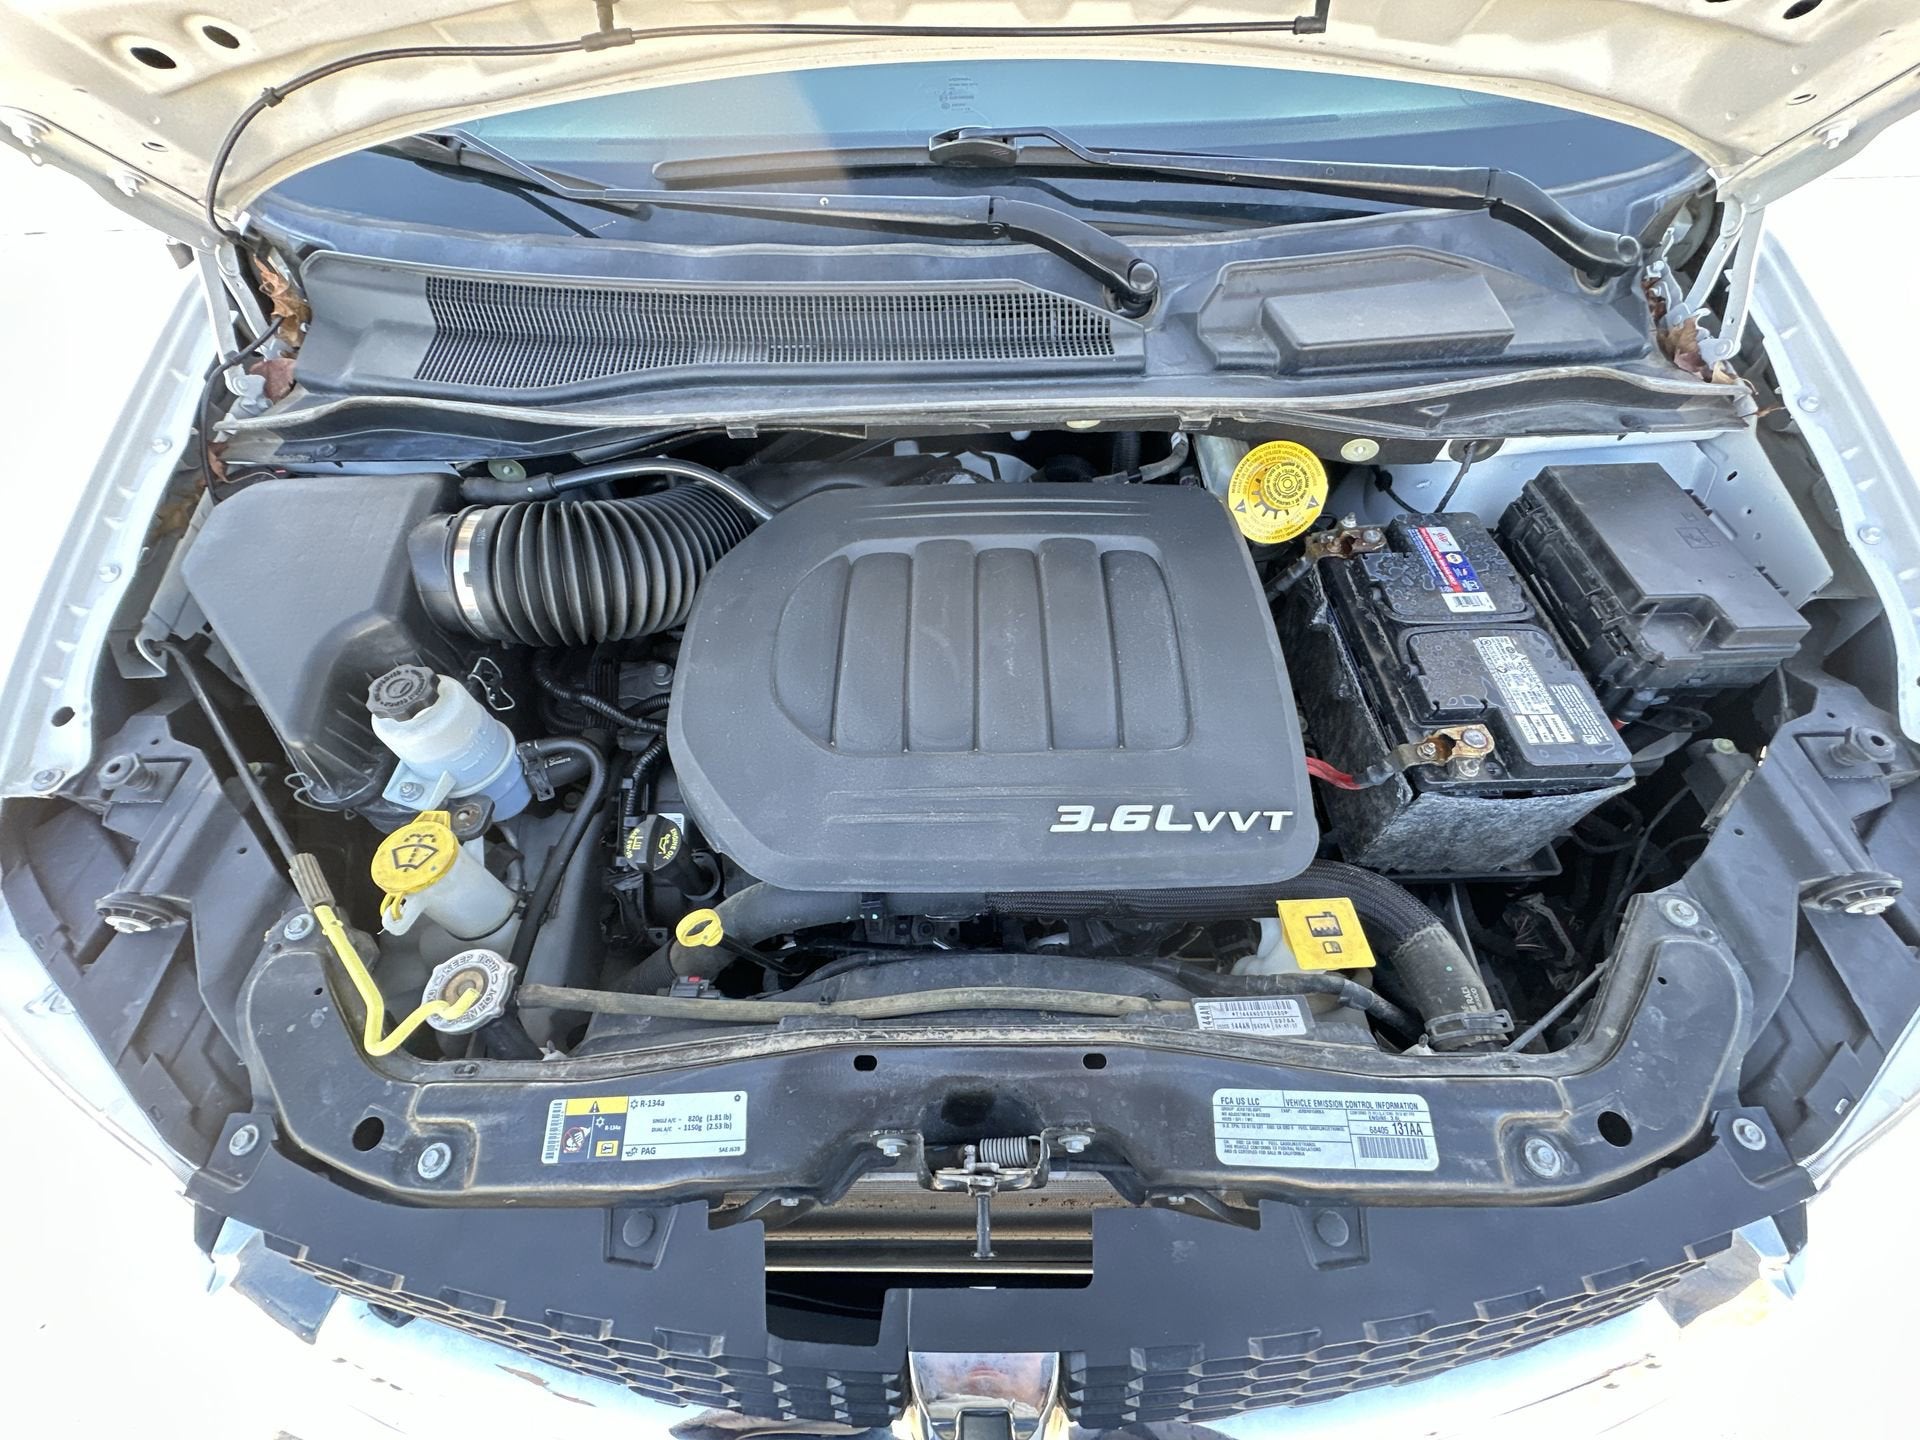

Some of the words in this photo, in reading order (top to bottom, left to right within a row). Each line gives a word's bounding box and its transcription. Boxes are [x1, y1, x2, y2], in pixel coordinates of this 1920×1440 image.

[1050, 804, 1193, 833] 3.6L
[1193, 811, 1294, 832] VVT
[669, 827, 679, 850] ENGINE
[662, 850, 675, 860] OIL
[443, 954, 474, 975] KEEP
[478, 953, 501, 974] TIGHT
[1198, 1005, 1214, 1030] 144AN
[640, 1099, 665, 1108] R-134a
[1220, 1096, 1234, 1105] FCA
[1236, 1097, 1246, 1105] US
[1247, 1097, 1260, 1106] LLC
[1286, 1099, 1312, 1108] VEHICLE
[1314, 1099, 1343, 1109] EMISSION
[1345, 1100, 1373, 1109] CONTROL
[1375, 1101, 1419, 1110] INFORMATION
[687, 1115, 703, 1123] 820g
[706, 1114, 722, 1123] (1.81
[722, 1114, 732, 1122] lb)
[683, 1123, 703, 1132] 1150g
[706, 1122, 722, 1131] (2.53
[722, 1122, 732, 1130] lb)
[1369, 1126, 1389, 1135] 68405
[1392, 1122, 1424, 1136] 131AA
[640, 1147, 657, 1155] PAG
